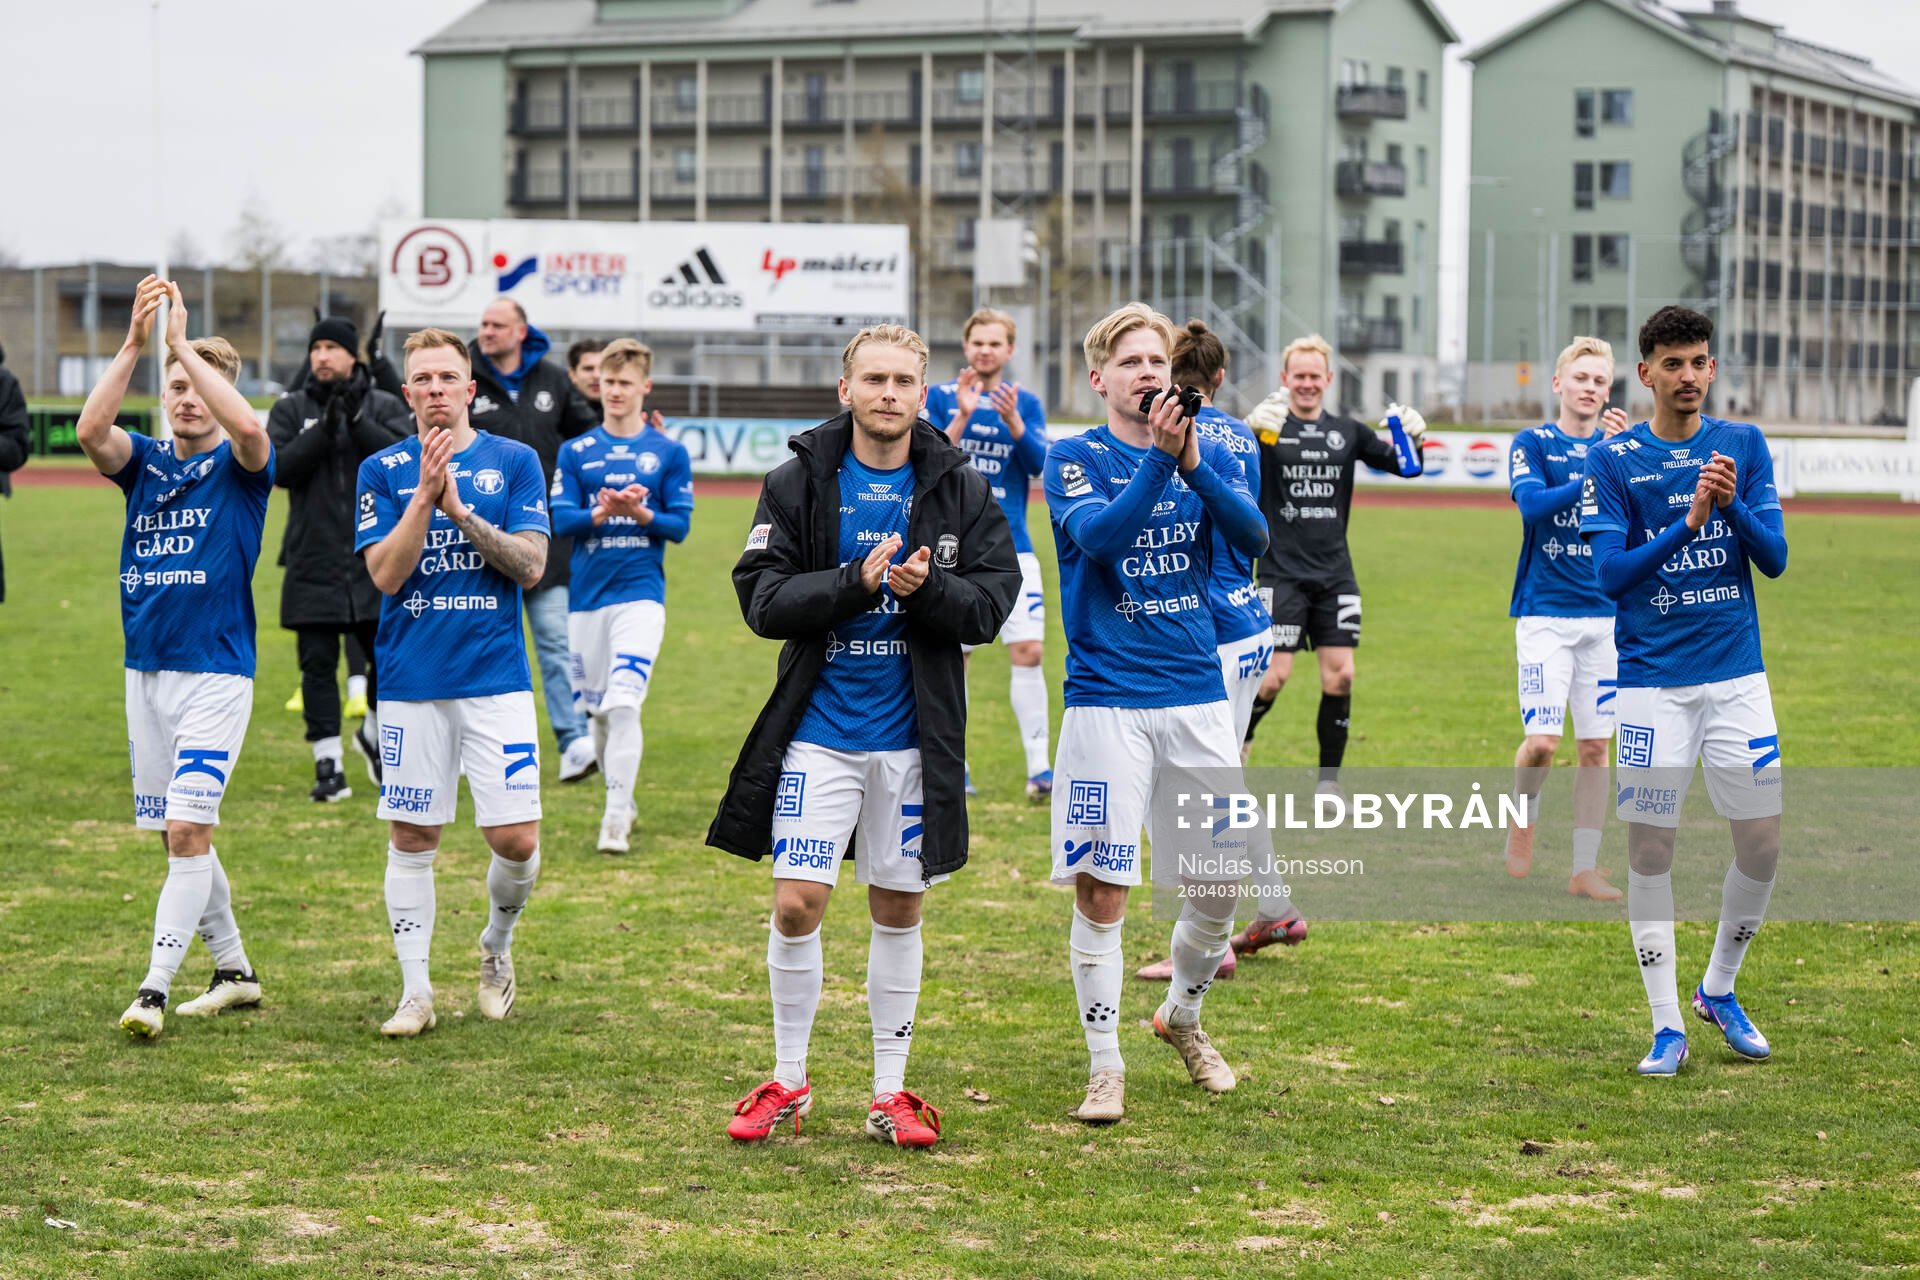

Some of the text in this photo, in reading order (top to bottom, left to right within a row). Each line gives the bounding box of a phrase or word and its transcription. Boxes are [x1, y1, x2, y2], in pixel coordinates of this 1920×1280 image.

[546, 253, 626, 274] INTER
[545, 274, 622, 295] SPORT
[647, 288, 743, 308] adidas
[969, 453, 1001, 474] ÅRD
[1282, 465, 1343, 480] MELLBY
[1663, 458, 1704, 469] TRELLEBORG
[1290, 479, 1334, 497] GÅRD
[1630, 475, 1655, 483] CRAFT
[857, 492, 902, 502] TRELLEBORG
[1554, 507, 1580, 527] GÅ
[1131, 522, 1200, 548] ELLBY
[136, 533, 194, 557] GÅRD
[1567, 544, 1592, 556] SIG
[421, 549, 485, 575] GÅRD
[1122, 552, 1190, 577] GÅRD
[389, 784, 432, 800] INTER
[1638, 786, 1676, 802] INTER
[387, 798, 431, 813] SPORT
[1635, 800, 1676, 815] SPORT
[790, 837, 834, 855] INTER
[1095, 840, 1134, 857] INTER
[788, 852, 832, 870] SPORT
[1092, 854, 1133, 872] SPORT
